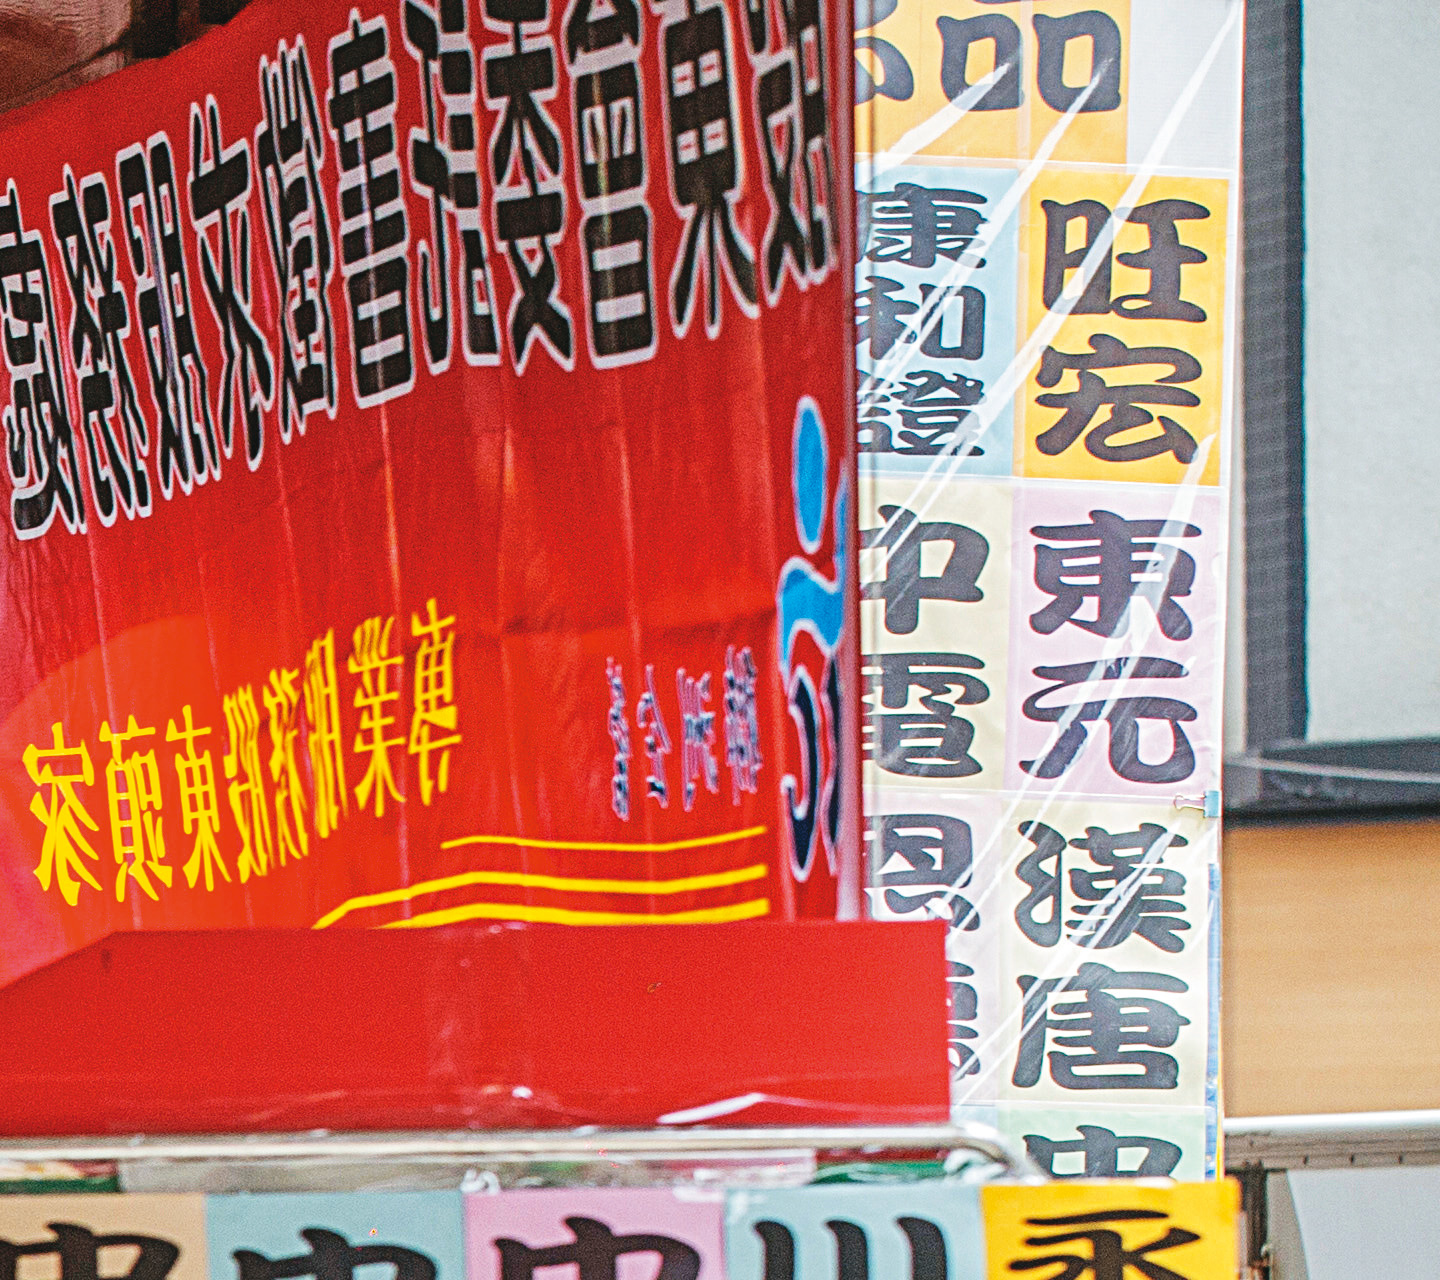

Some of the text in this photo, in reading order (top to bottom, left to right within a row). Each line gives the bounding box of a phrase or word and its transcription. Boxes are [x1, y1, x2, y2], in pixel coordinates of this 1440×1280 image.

[1035, 200, 1211, 464] 旺宏
[1019, 510, 1203, 784] 東元
[1012, 821, 1192, 1090] 漢唐
